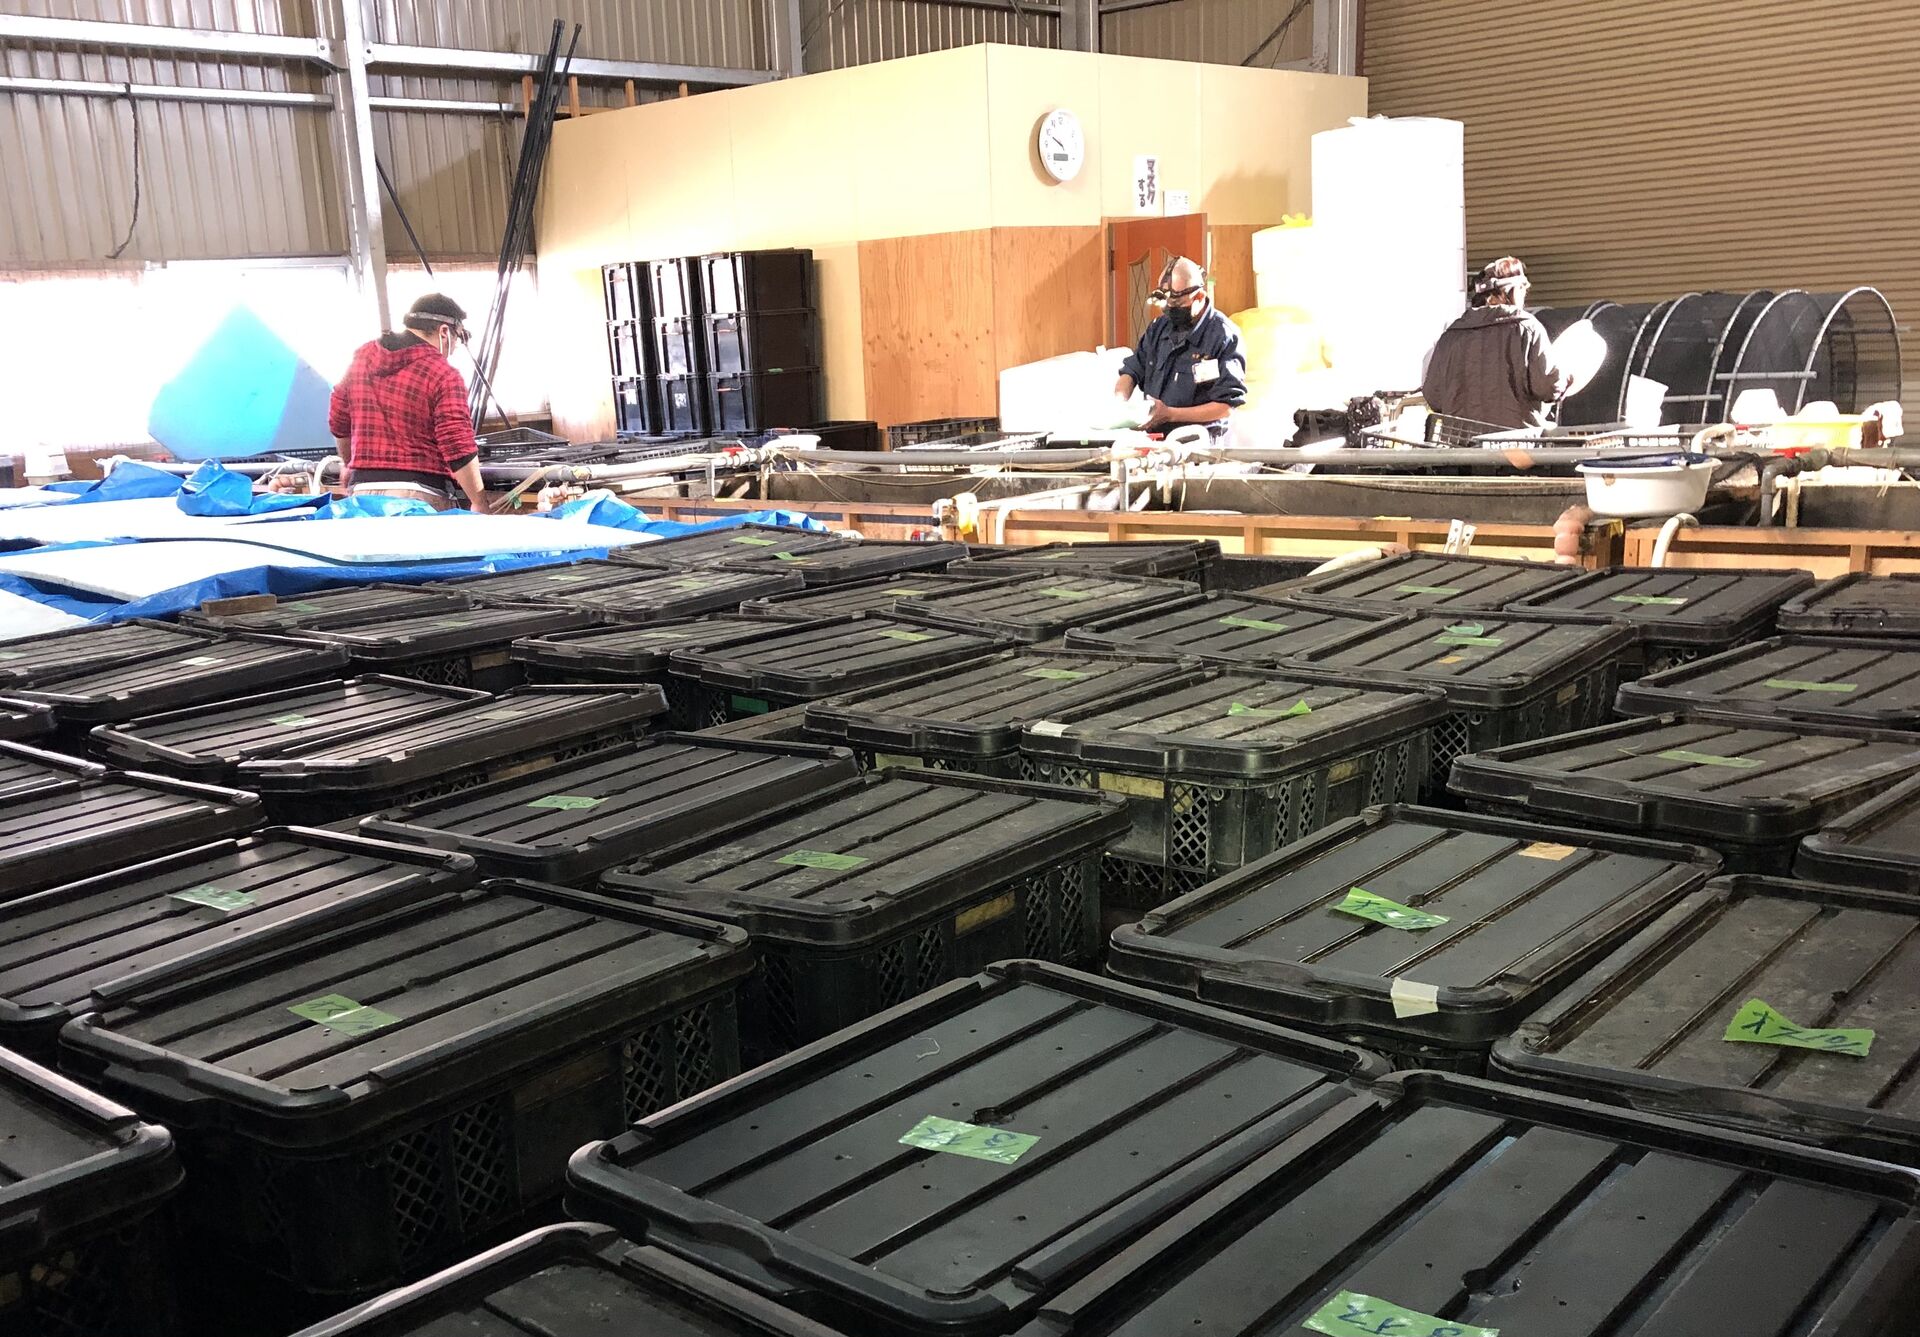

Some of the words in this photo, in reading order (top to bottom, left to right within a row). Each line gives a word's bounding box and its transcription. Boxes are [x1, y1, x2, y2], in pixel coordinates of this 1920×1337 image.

[1137, 178, 1146, 207] する
[1146, 158, 1155, 205] マスク
